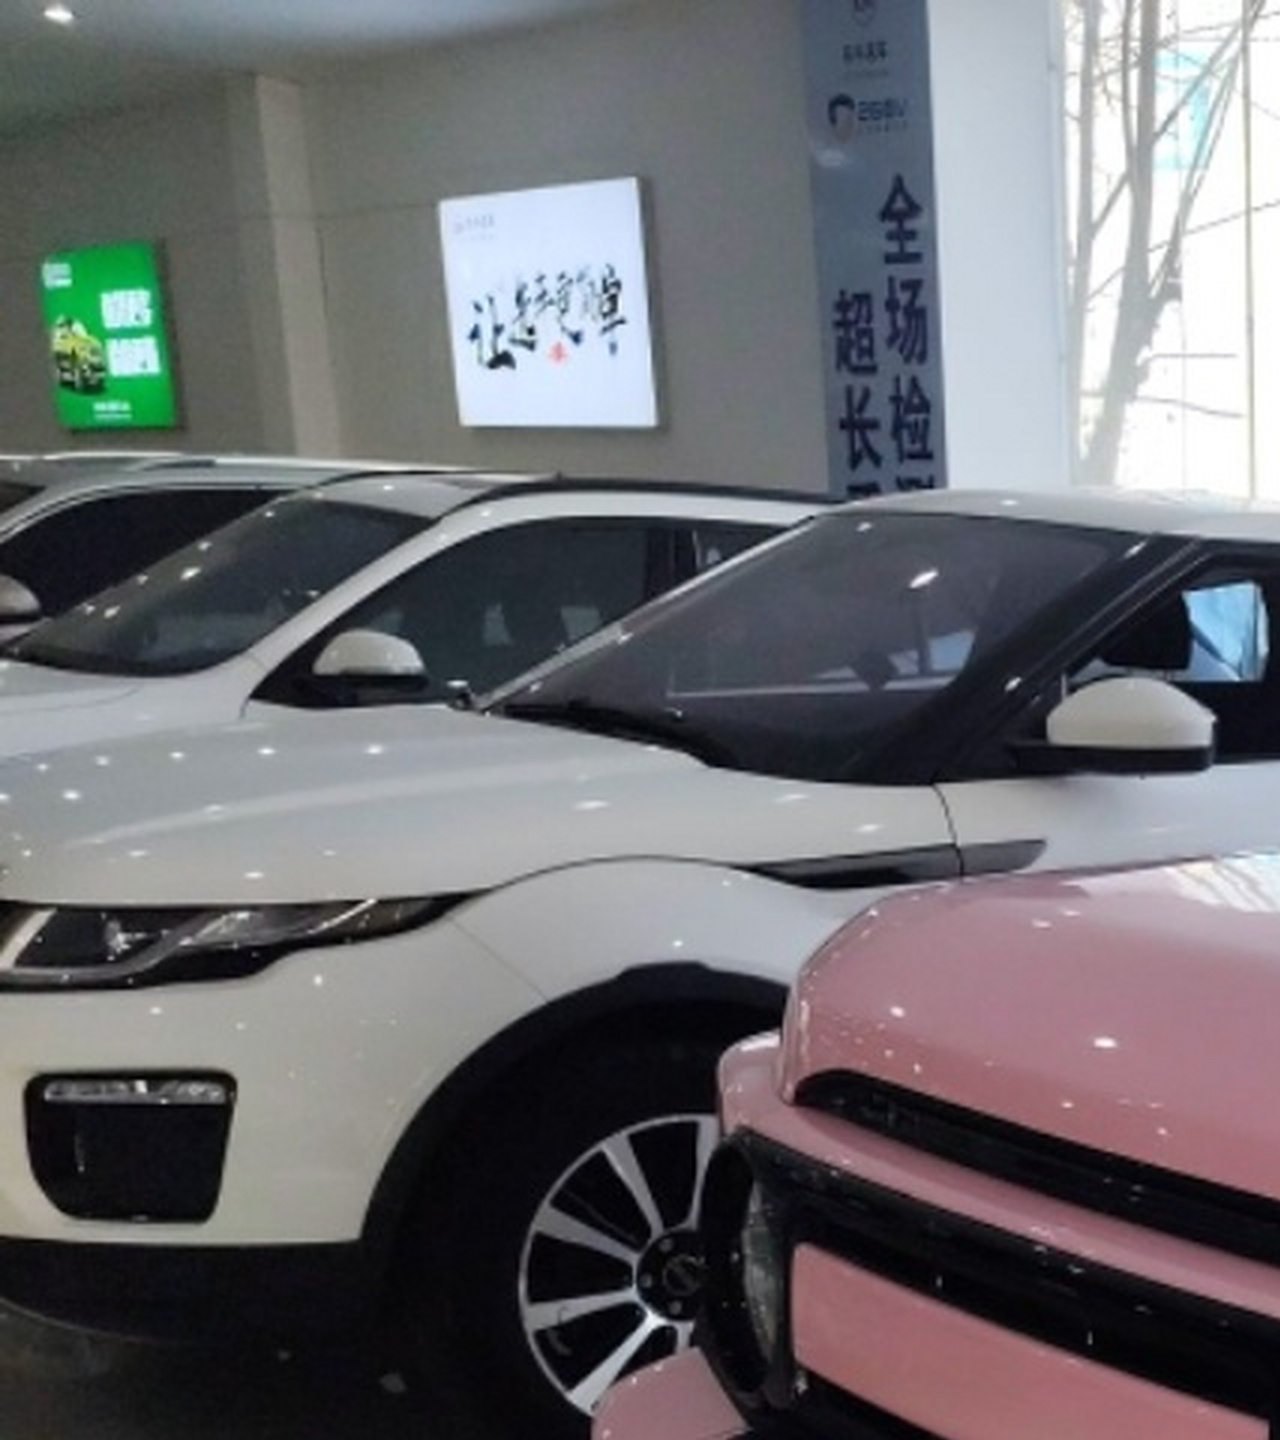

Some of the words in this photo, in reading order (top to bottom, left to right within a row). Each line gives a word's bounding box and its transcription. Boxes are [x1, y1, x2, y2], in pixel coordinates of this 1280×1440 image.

[833, 288, 883, 498] 超长
[878, 173, 935, 490] 全场检
